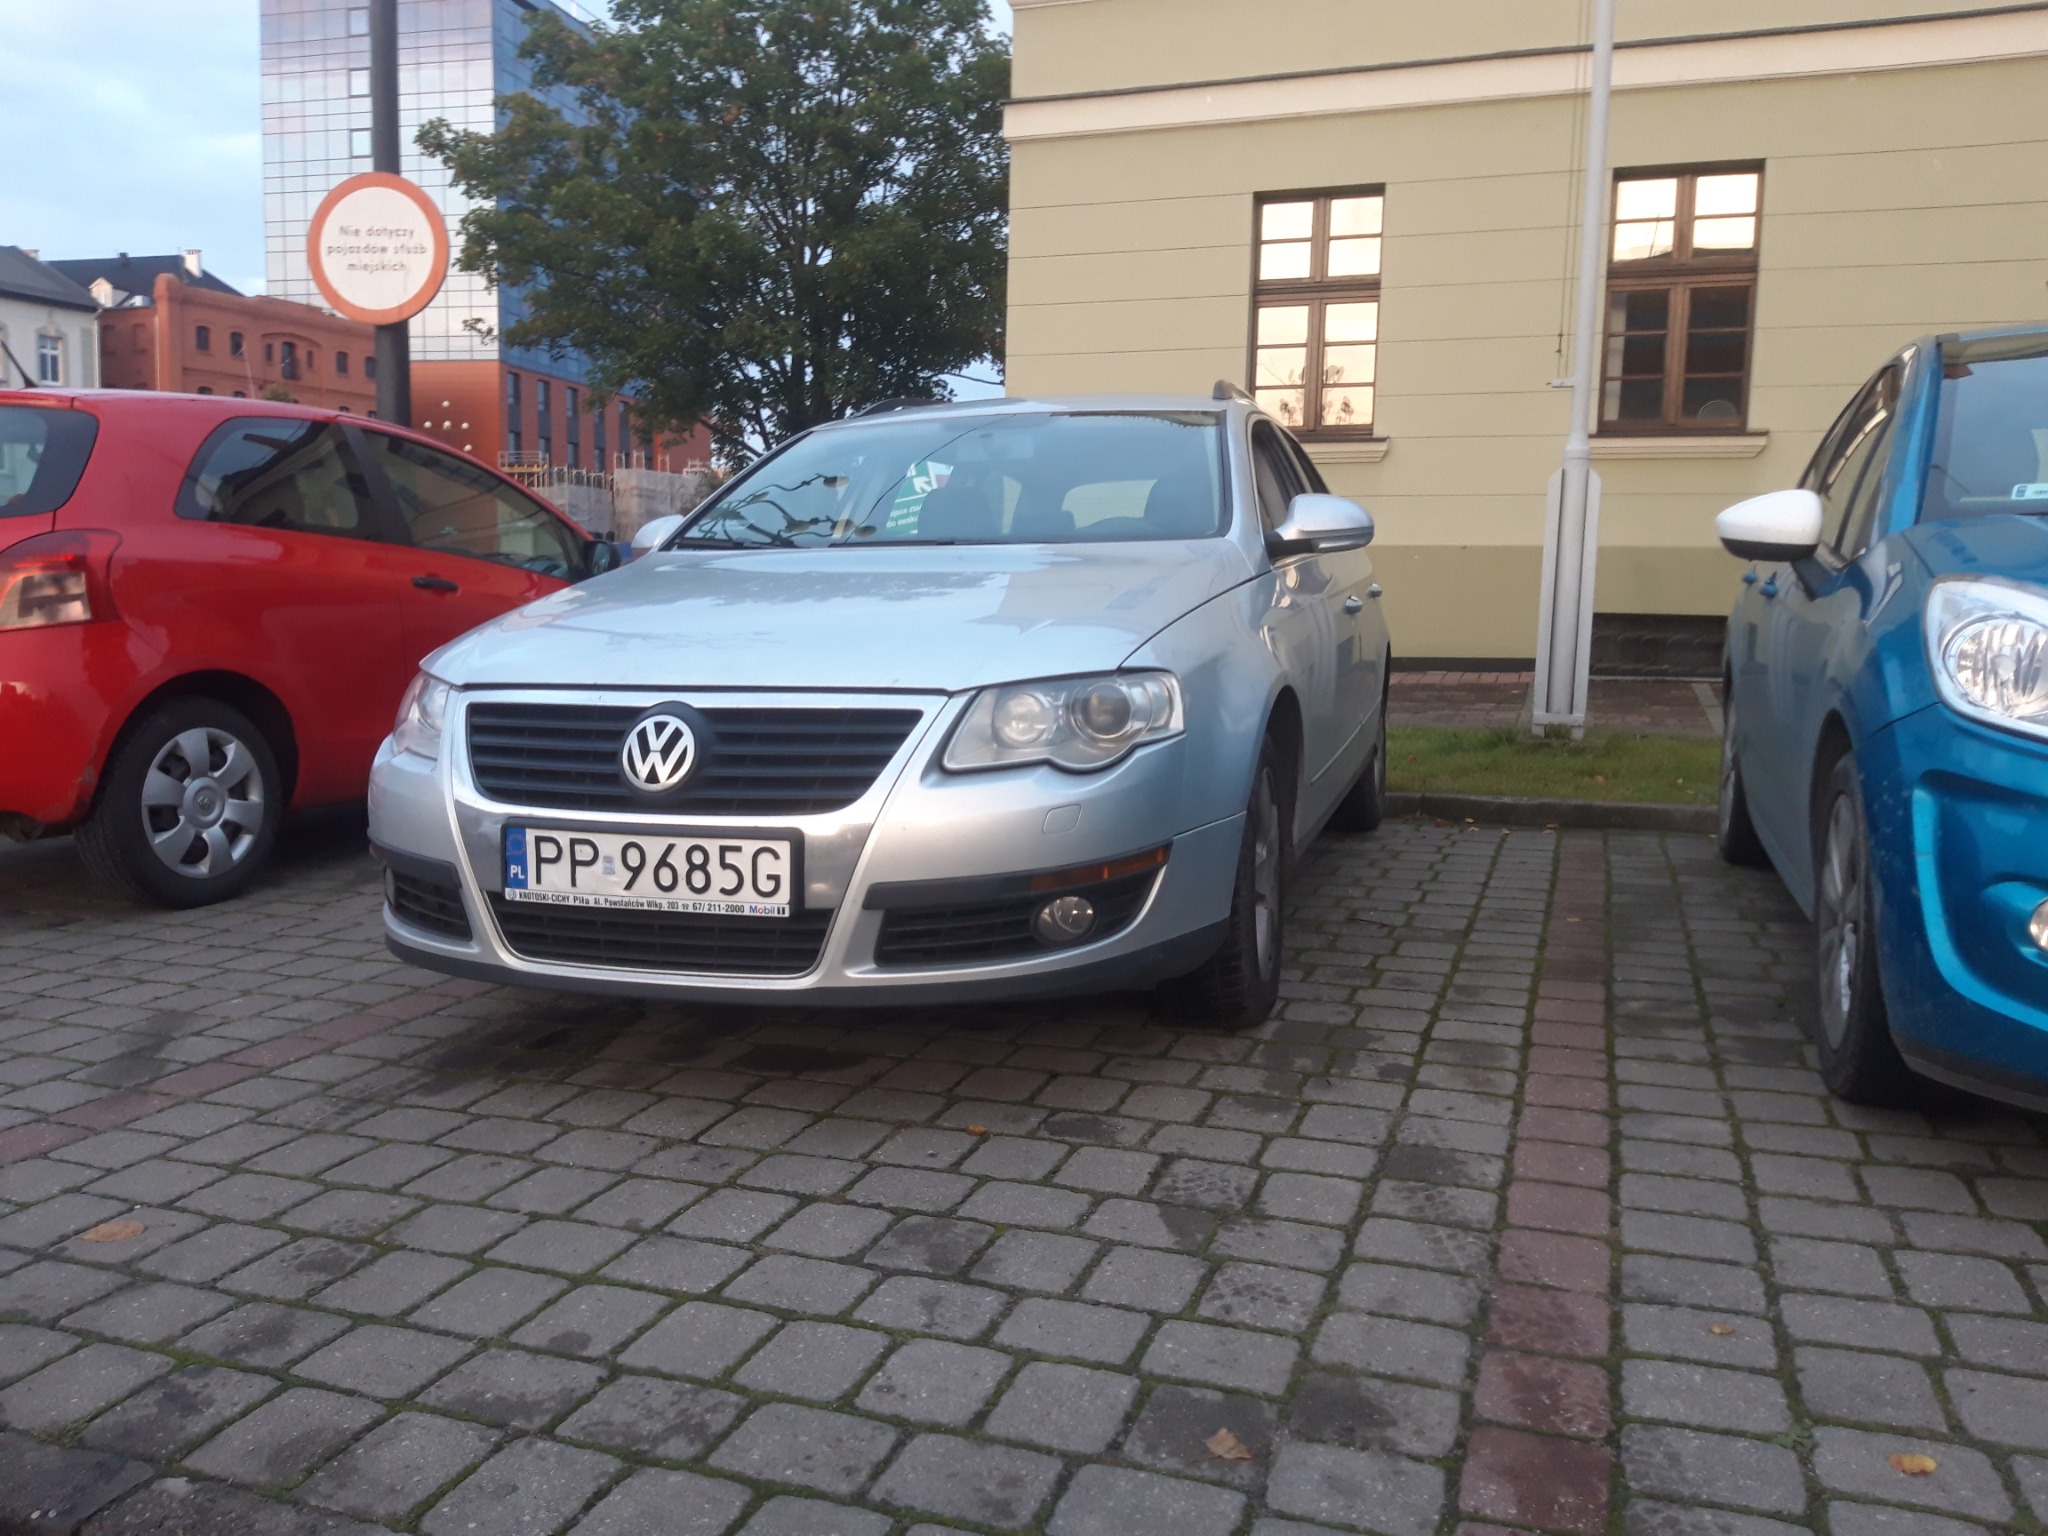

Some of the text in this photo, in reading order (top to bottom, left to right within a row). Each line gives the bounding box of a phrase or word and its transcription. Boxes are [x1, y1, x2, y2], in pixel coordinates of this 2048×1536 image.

[339, 225, 415, 239] Nie dotyczy
[327, 243, 388, 256] pojazdów
[346, 260, 407, 273] miejskich
[510, 864, 525, 879] PL
[534, 834, 782, 899] PP 9685G
[518, 891, 570, 903] KROTOSKI-CICHY
[573, 895, 590, 905] Piła
[593, 897, 603, 906] Al.
[604, 898, 645, 909] Powstańców
[646, 900, 666, 911] Wlkp.
[667, 901, 679, 910] 203
[707, 903, 745, 914] 211-2000
[749, 905, 775, 915] Mobil
